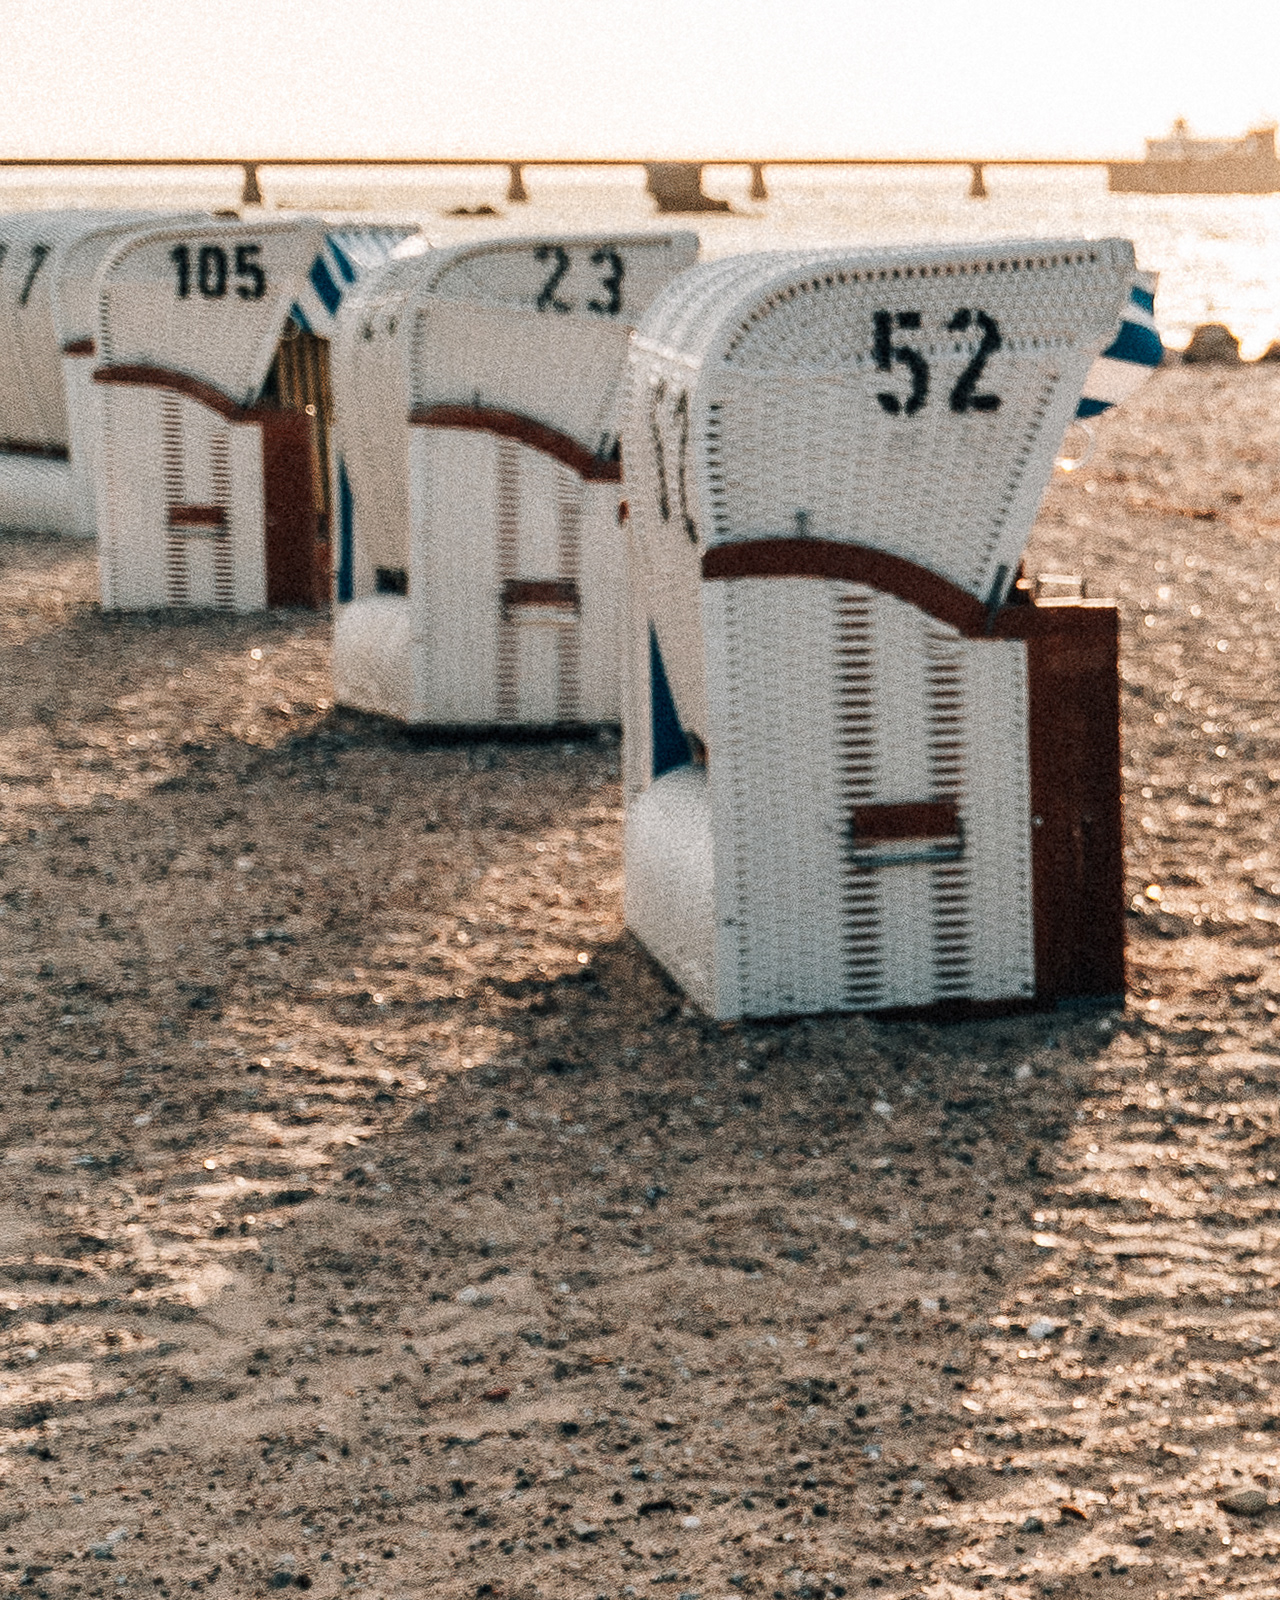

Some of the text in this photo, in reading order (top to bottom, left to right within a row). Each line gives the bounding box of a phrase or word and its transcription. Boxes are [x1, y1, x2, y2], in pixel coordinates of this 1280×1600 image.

[0, 242, 51, 306] 7
[170, 244, 266, 299] 105
[534, 246, 624, 314] 23
[872, 308, 1002, 416] 52
